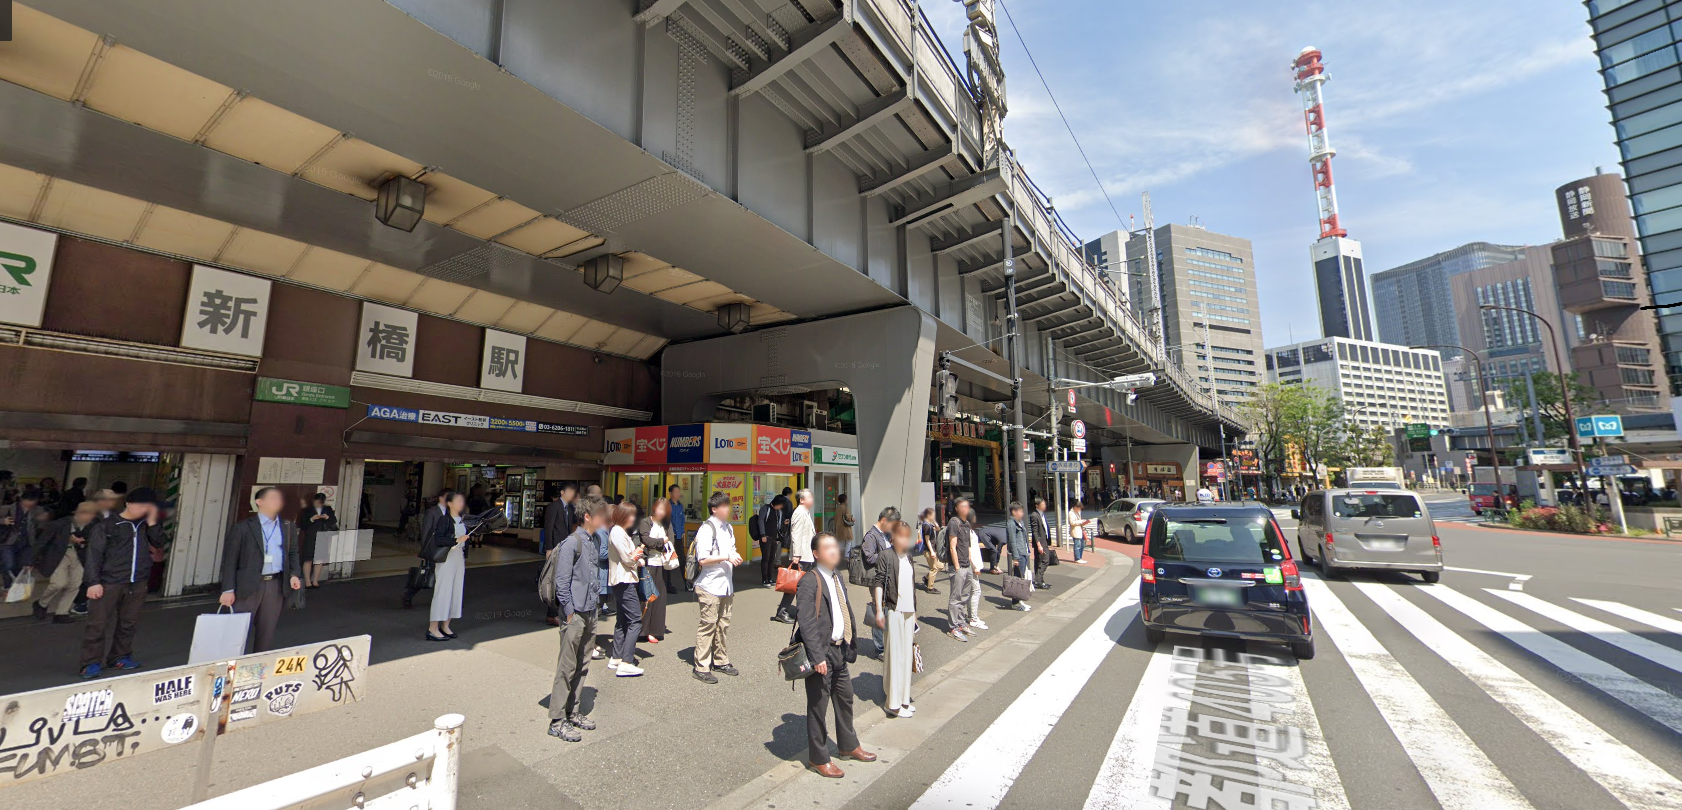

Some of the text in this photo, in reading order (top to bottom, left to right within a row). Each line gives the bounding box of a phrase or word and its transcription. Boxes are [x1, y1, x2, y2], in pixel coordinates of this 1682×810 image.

[272, 382, 300, 397] JR
[421, 412, 462, 424] EAST
[606, 440, 622, 453] LOTO
[636, 437, 667, 453] 宝くじ
[669, 435, 702, 448] NUMBERS
[714, 437, 734, 449] LOTO
[757, 435, 791, 455] 宝くじ
[275, 656, 306, 674] 24K
[155, 675, 193, 697] HALF
[264, 682, 302, 701] PUTS
[155, 688, 192, 704] WAS HERE
